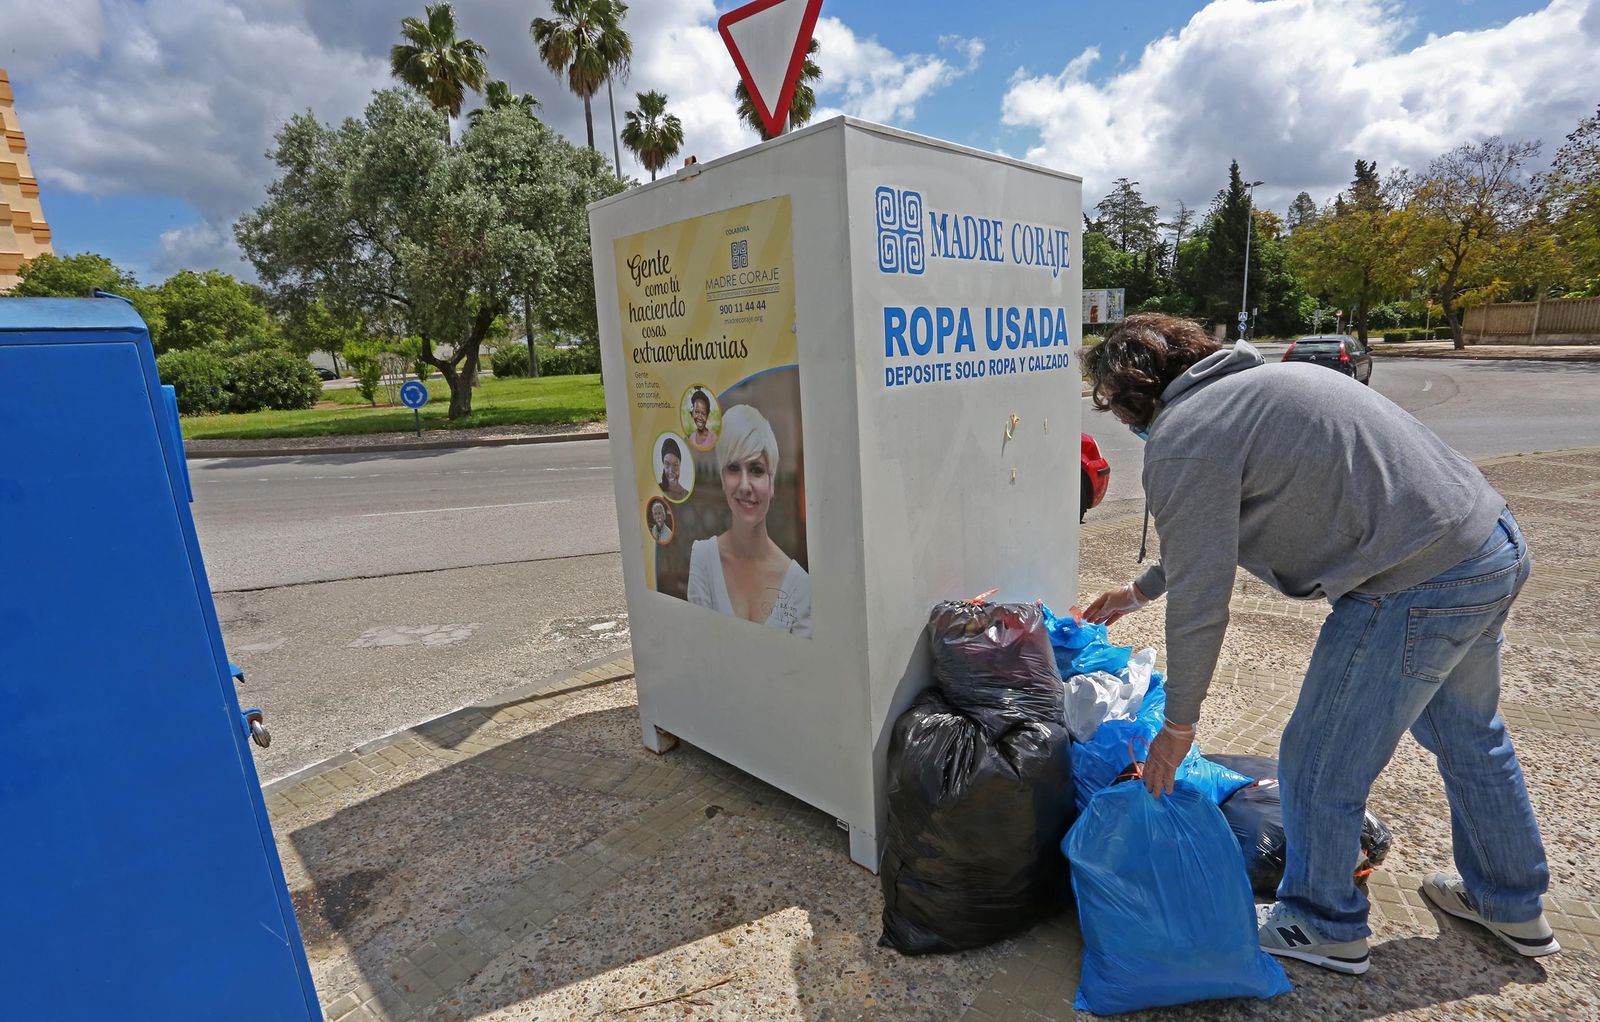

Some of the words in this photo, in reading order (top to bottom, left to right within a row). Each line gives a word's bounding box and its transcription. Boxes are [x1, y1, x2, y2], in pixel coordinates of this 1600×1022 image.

[929, 211, 1004, 262] MADRE
[1011, 222, 1070, 278] CORAJE
[627, 249, 671, 287] Gente
[705, 274, 737, 291] MADRE
[739, 267, 780, 285] CORAJE
[645, 281, 669, 297] como
[669, 274, 680, 293] tú
[629, 295, 686, 323] haciendo
[719, 303, 733, 315] 900
[735, 303, 744, 312] 11
[745, 301, 755, 311] 44
[756, 300, 766, 310] 44
[641, 324, 667, 339] cosas
[884, 306, 976, 357] ROPA
[985, 306, 1069, 351] USADA
[633, 335, 748, 364] extraordinarias
[634, 371, 649, 379] Gente
[885, 363, 952, 387] DEPOSITE
[955, 359, 986, 380] SOLO
[989, 357, 1017, 376] ROPA
[1019, 357, 1026, 372] Y
[1028, 353, 1069, 372] CALZADO
[1275, 924, 1312, 948] N
